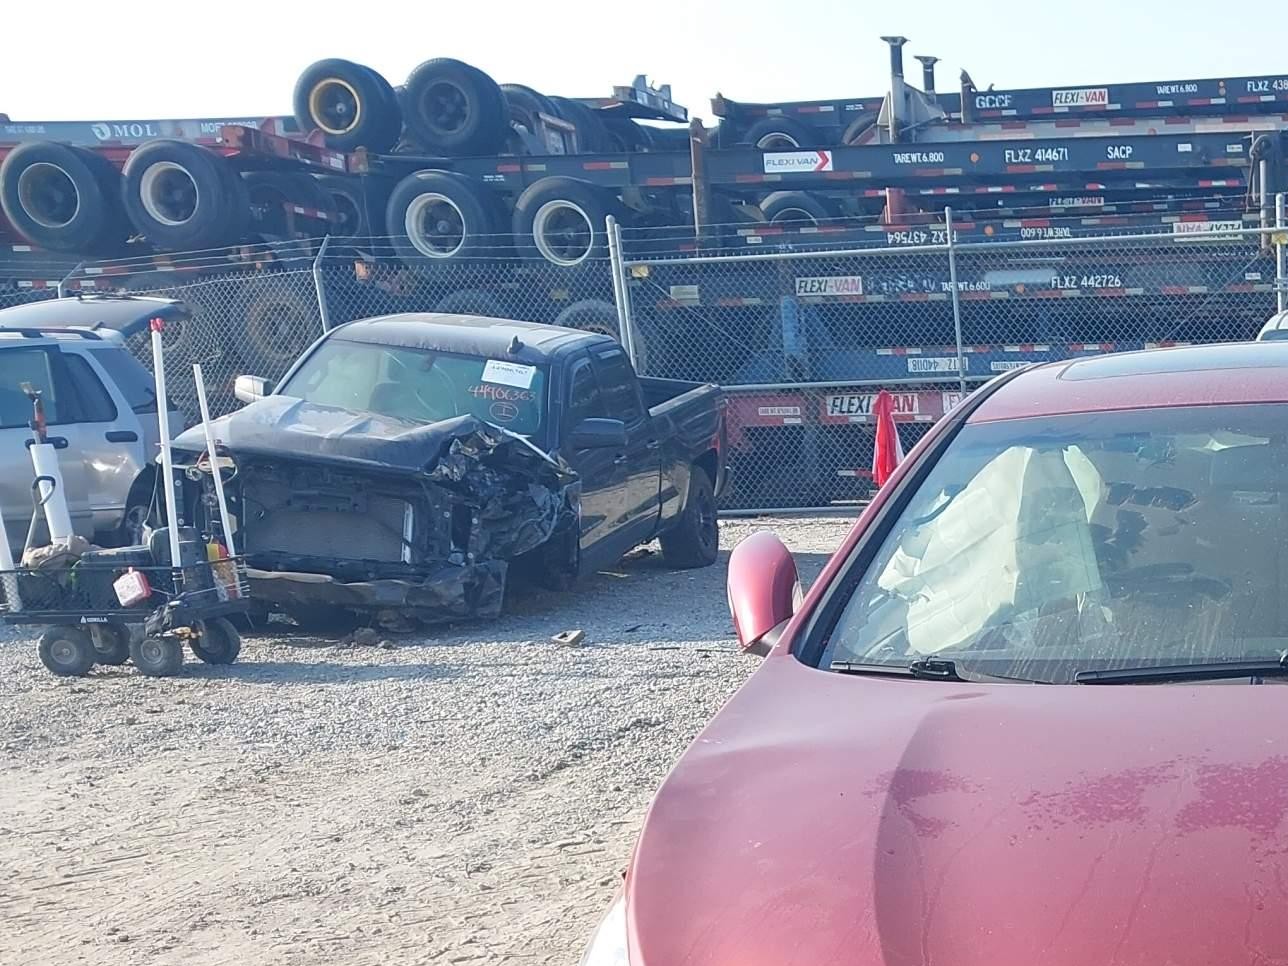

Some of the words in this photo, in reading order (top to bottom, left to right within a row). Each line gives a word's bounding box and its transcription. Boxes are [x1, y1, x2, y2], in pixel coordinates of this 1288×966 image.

[1247, 81, 1269, 92] FLXZ
[1054, 91, 1106, 105] FLEXI-VAN
[114, 123, 156, 137] MOL
[1005, 149, 1032, 163] FLXZ
[1034, 148, 1068, 161] 414671
[1107, 146, 1133, 159] SACP
[886, 231, 929, 244] 437564
[798, 277, 861, 293] FLEXI-VAN
[1052, 277, 1077, 288] FLXZ
[1080, 275, 1121, 288] 442726
